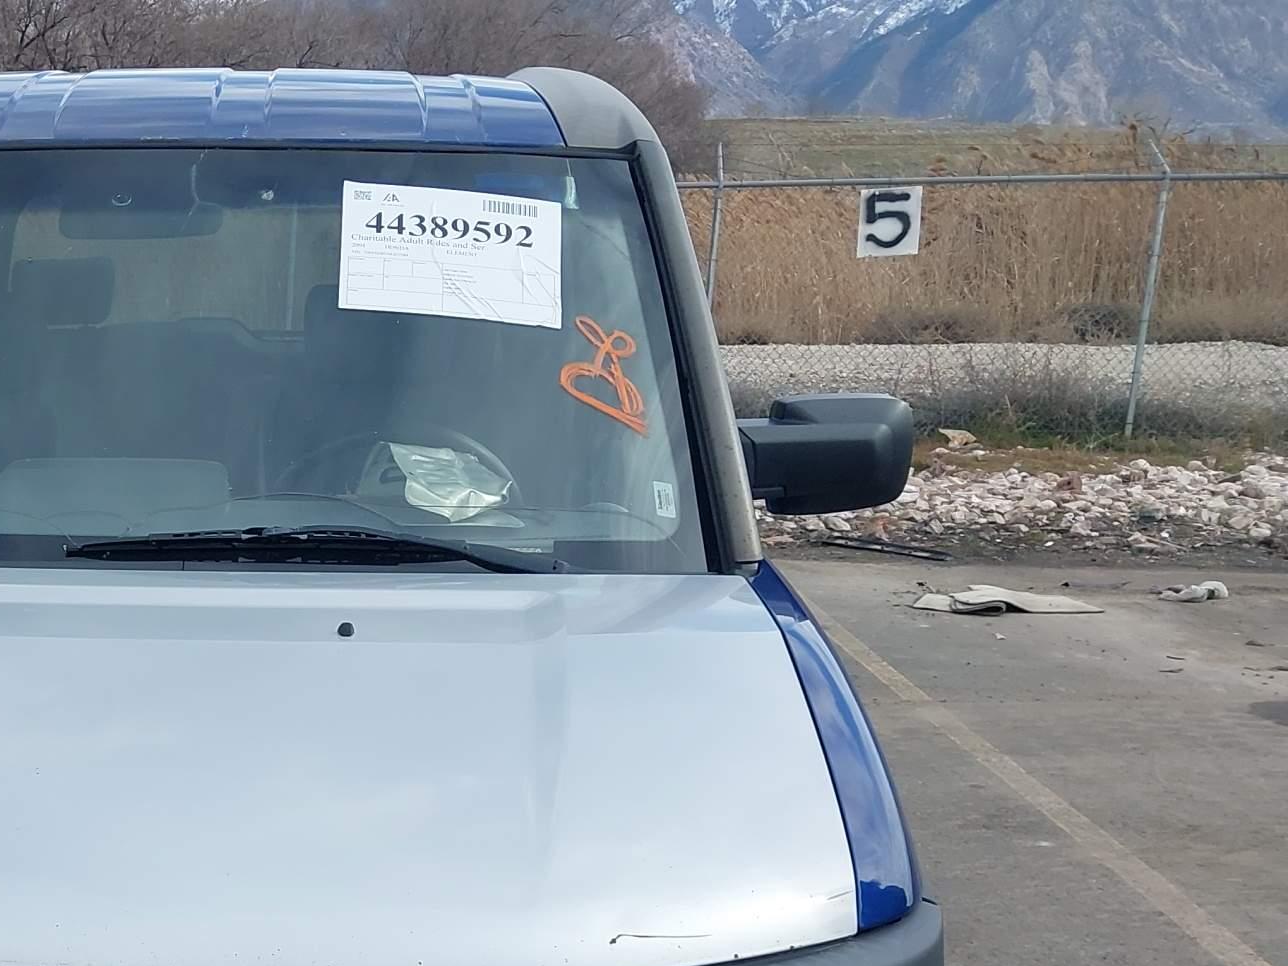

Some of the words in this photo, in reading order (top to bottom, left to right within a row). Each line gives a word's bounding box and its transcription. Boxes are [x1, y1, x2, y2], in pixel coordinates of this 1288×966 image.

[365, 212, 534, 249] 44389592
[866, 192, 911, 249] 5
[351, 234, 397, 243] Charitable
[399, 236, 424, 245] Adult
[427, 238, 450, 247] Rdes
[453, 241, 468, 249] and
[471, 243, 486, 251] Ser
[446, 249, 477, 257] ELEMENT
